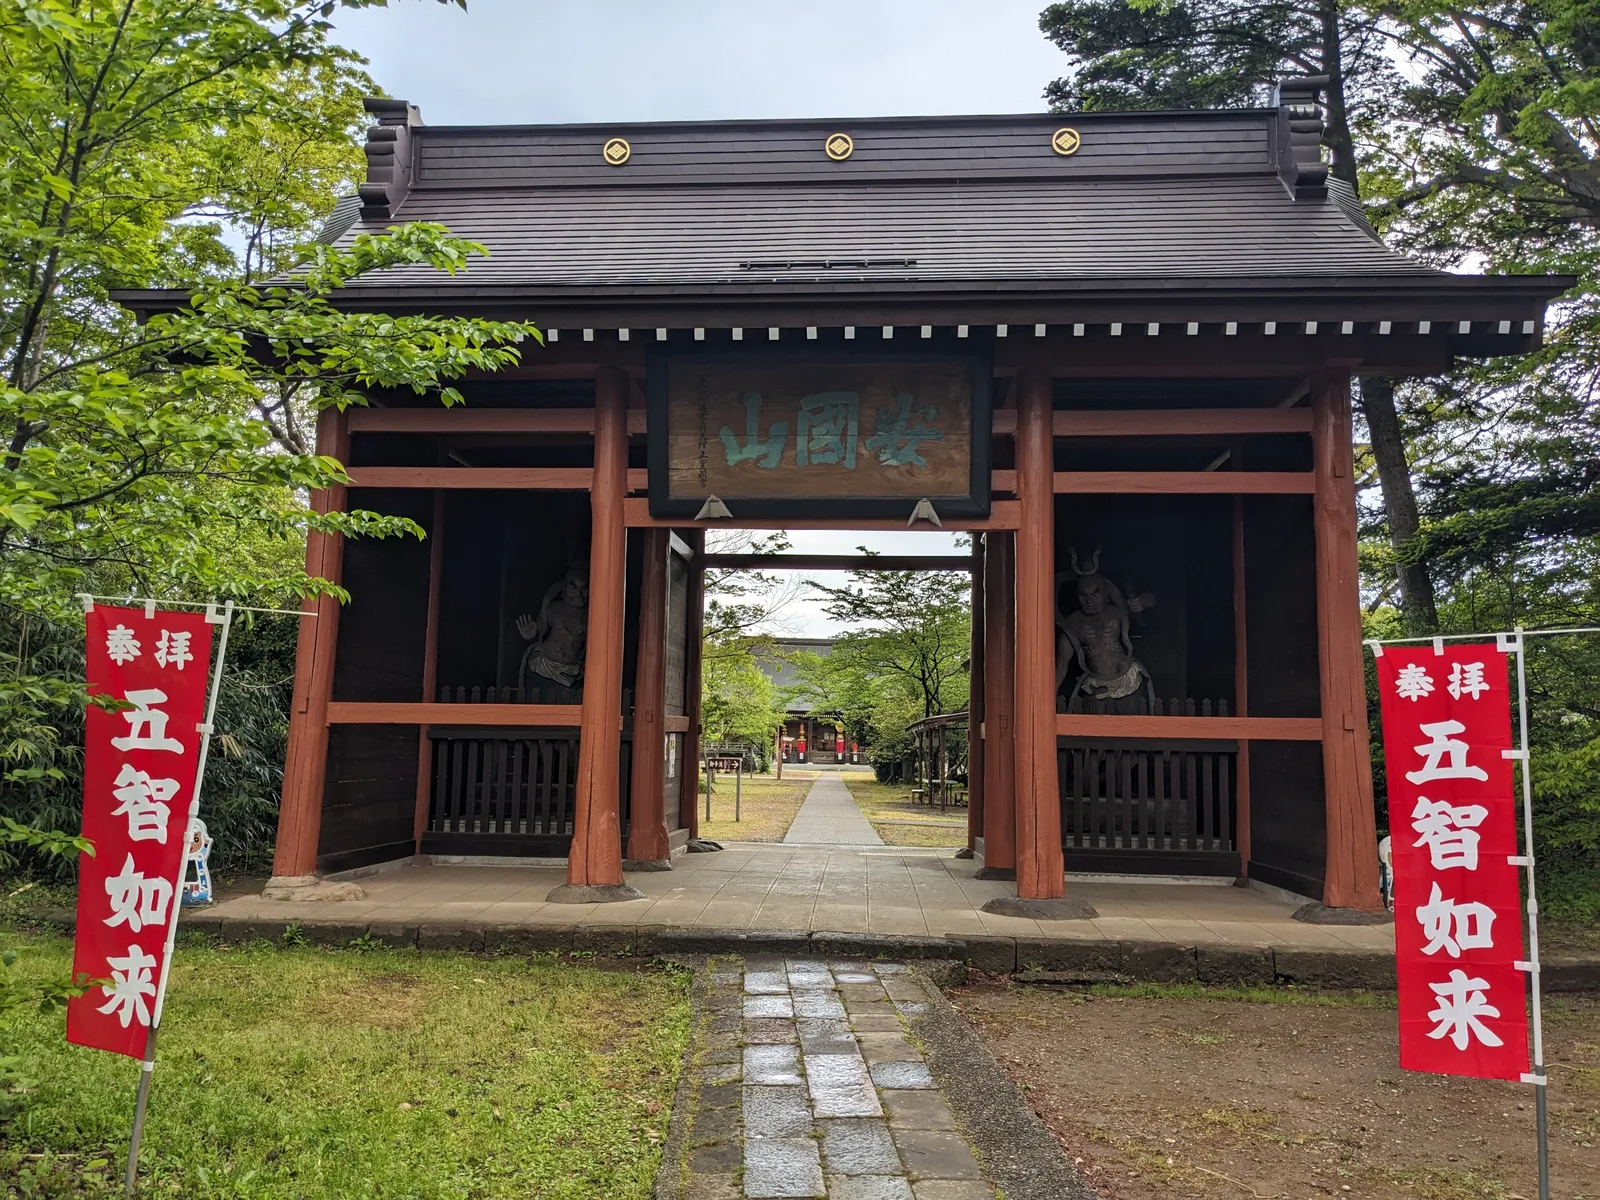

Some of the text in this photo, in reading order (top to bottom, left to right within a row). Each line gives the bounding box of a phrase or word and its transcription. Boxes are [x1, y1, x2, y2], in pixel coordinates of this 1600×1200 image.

[105, 623, 195, 671] 奉拝
[1395, 661, 1491, 702] 奉拝
[96, 688, 185, 1029] 五智如来
[1405, 719, 1504, 1051] 五智如来
